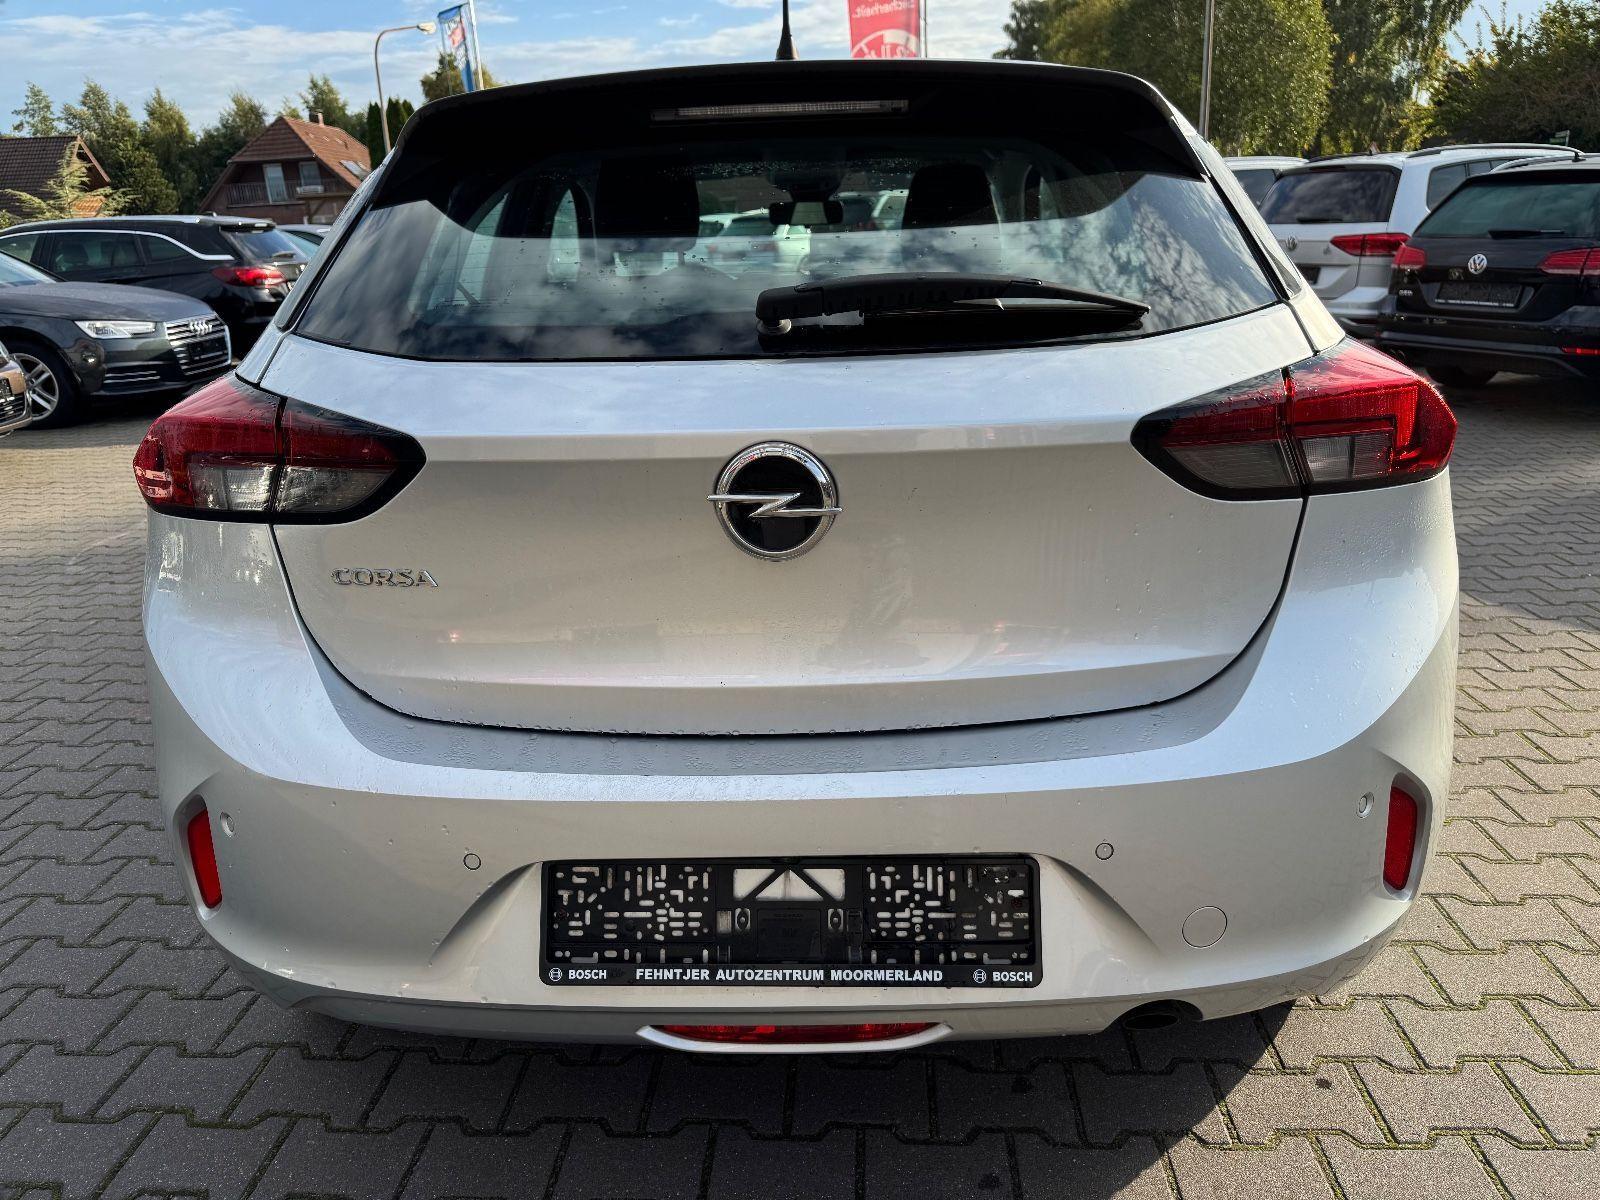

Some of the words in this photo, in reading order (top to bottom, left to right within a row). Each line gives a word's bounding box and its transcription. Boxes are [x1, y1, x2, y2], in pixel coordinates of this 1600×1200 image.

[331, 568, 438, 587] CORSA
[568, 969, 607, 980] BOSCH
[635, 968, 710, 981] FEHNTJER
[715, 969, 824, 981] AUTOZENTRUM
[830, 969, 943, 982] MOORMERLAND
[992, 971, 1033, 982] BOSCH
